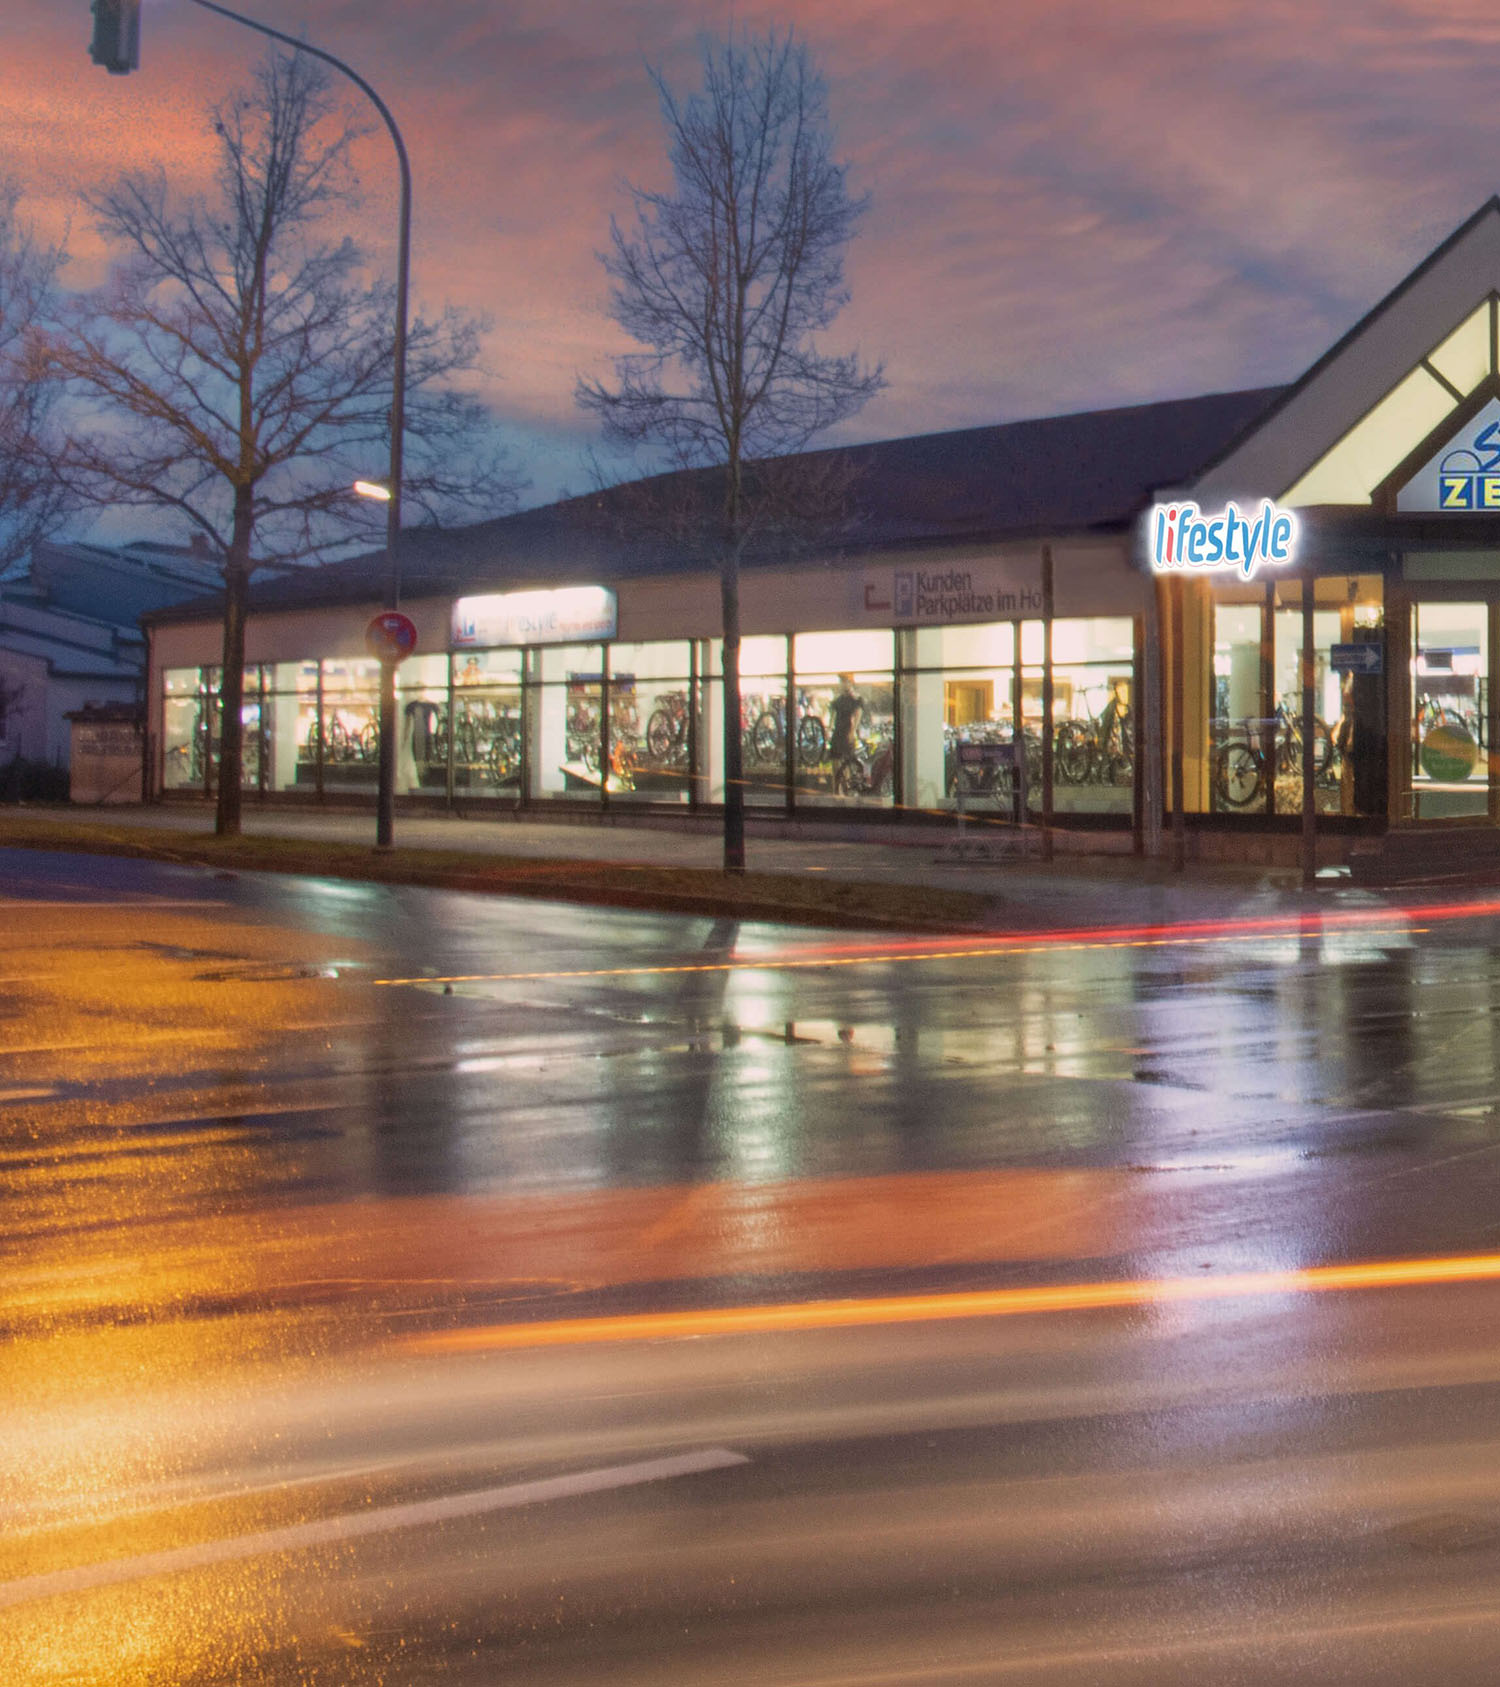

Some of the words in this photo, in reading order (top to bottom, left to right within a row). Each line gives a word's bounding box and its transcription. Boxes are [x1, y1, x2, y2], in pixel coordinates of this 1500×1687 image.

[1156, 504, 1291, 573] lifestyle
[917, 571, 972, 593] Kunden
[917, 592, 994, 617] Parkplätze
[997, 587, 1016, 611] im
[1020, 586, 1043, 610] Ho
